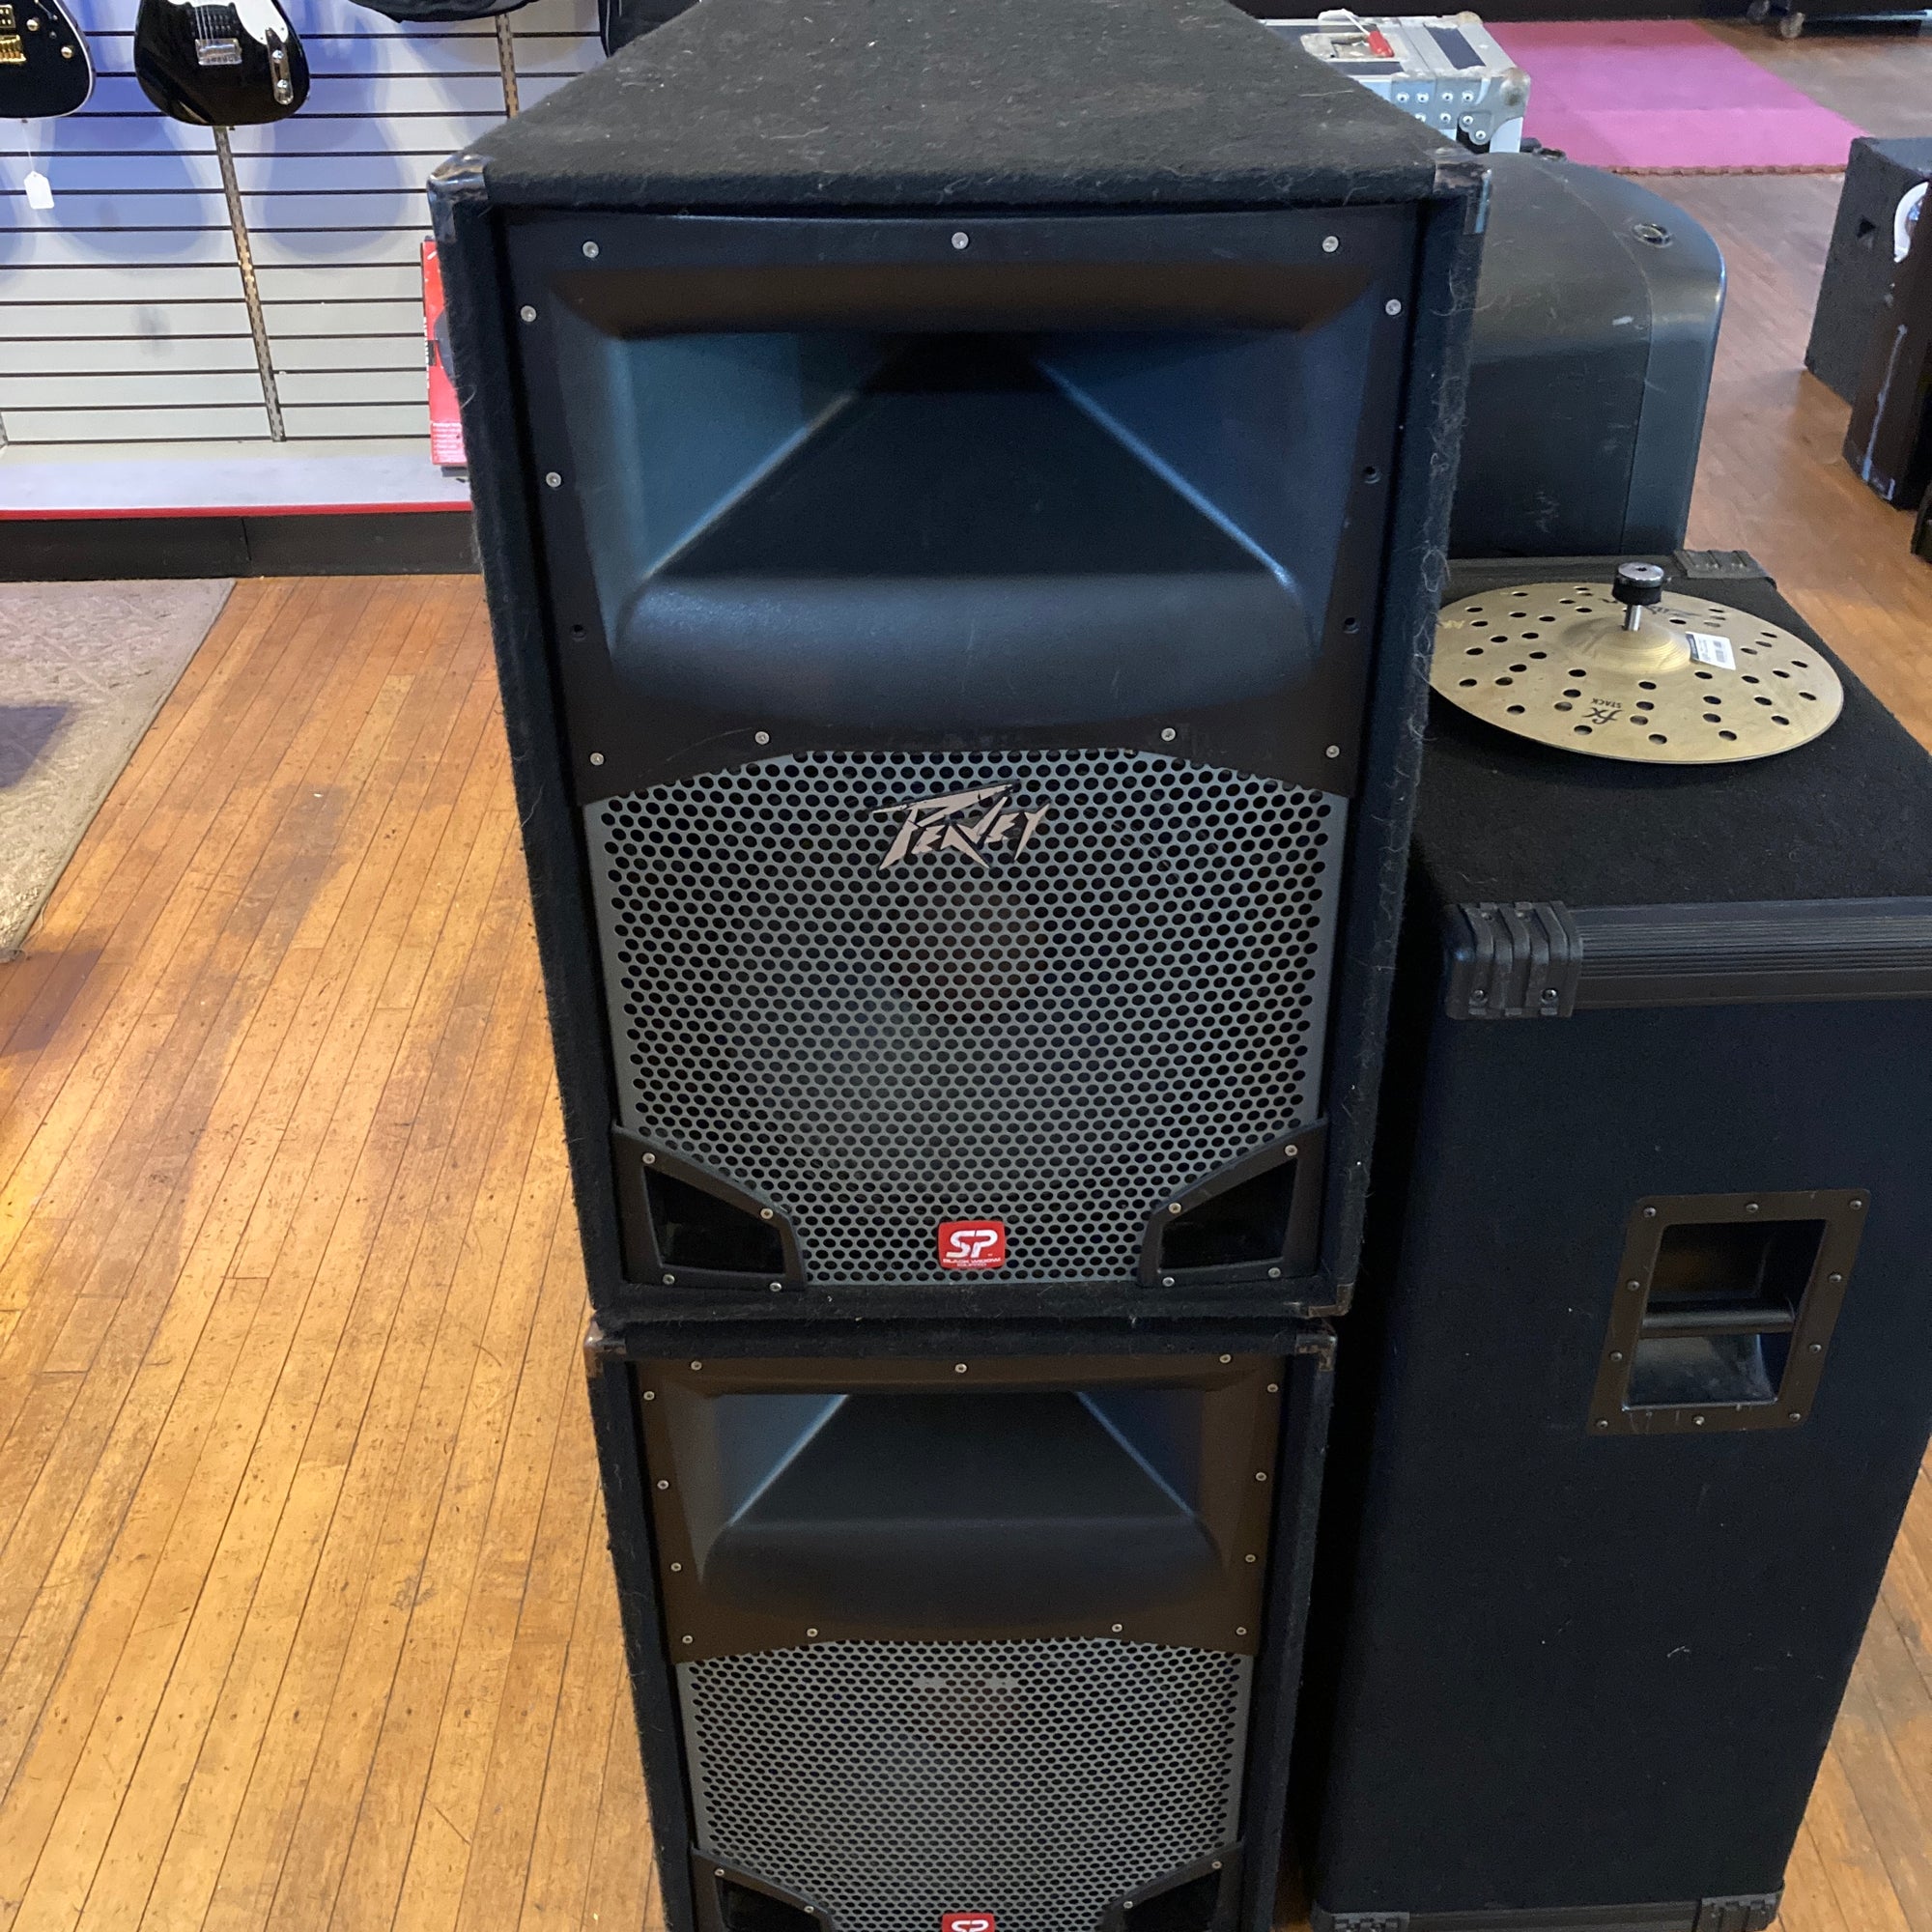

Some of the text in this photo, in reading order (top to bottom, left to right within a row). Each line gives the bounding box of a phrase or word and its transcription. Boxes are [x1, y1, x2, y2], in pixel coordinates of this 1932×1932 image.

[1591, 697, 1622, 708] STACK
[871, 781, 1050, 870] PEAVEY
[947, 1230, 998, 1258] SP
